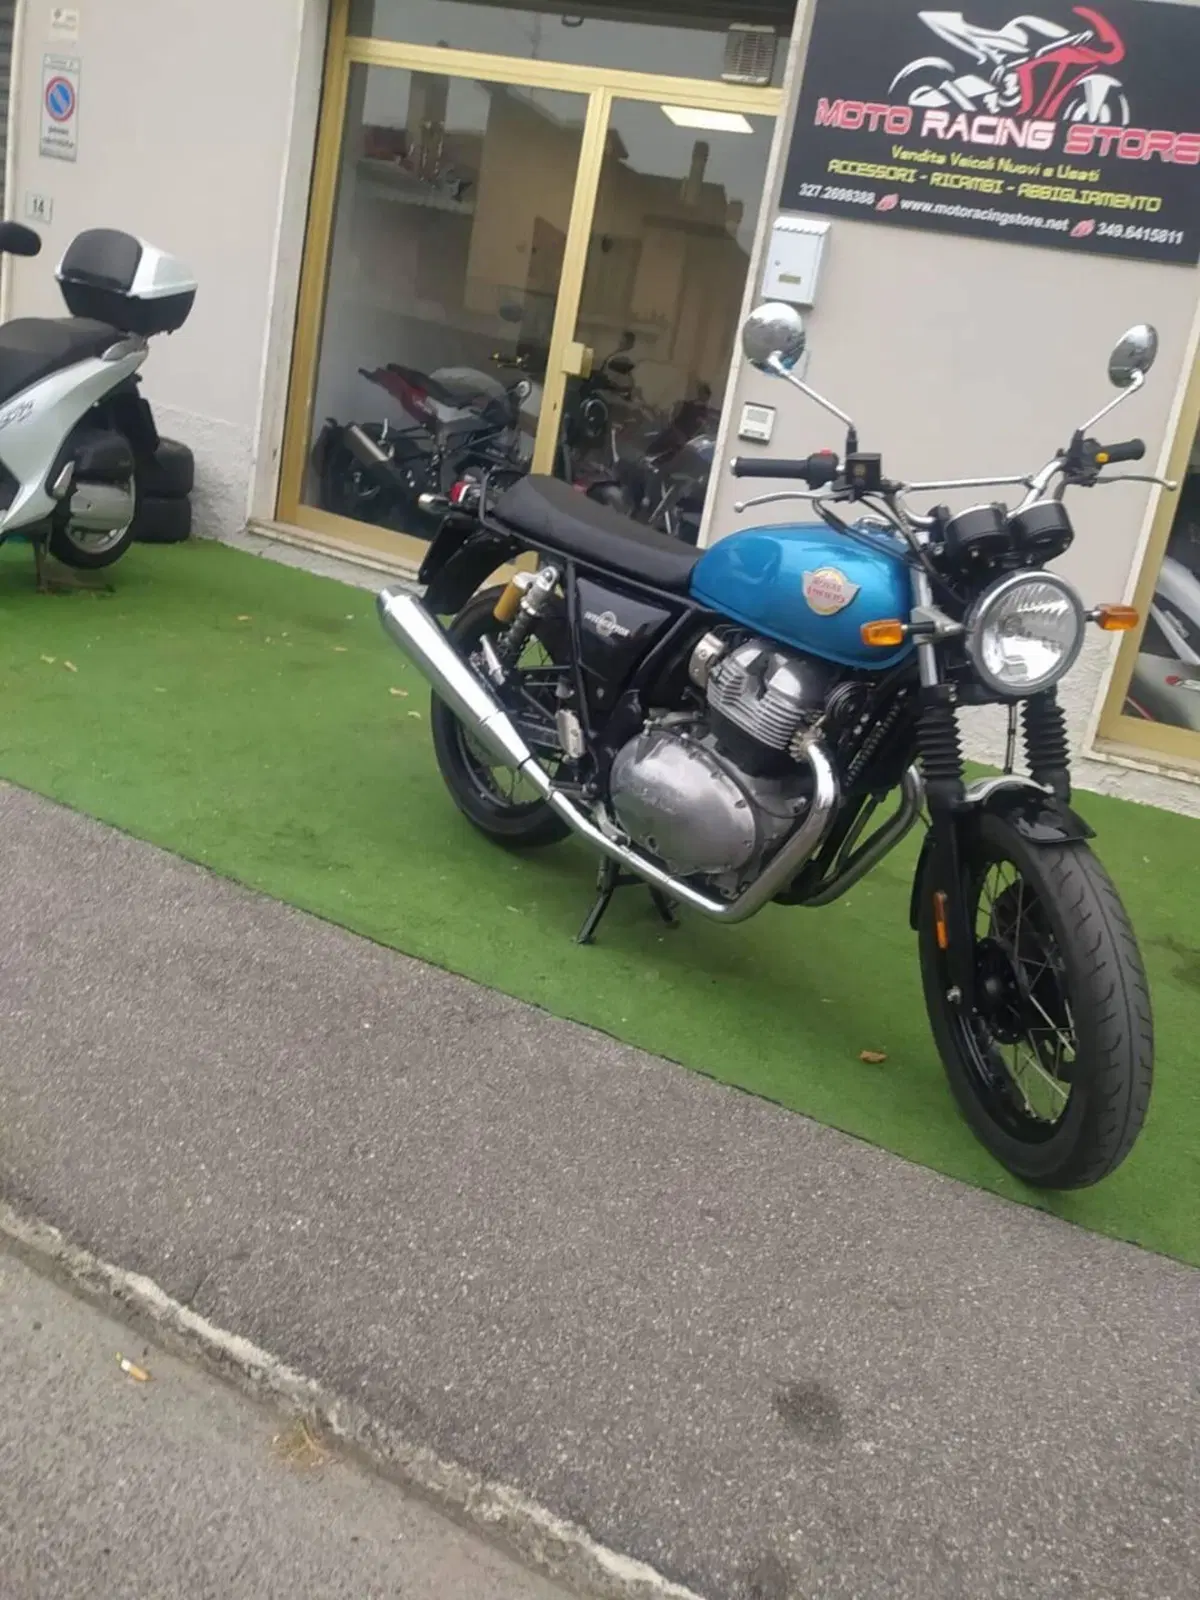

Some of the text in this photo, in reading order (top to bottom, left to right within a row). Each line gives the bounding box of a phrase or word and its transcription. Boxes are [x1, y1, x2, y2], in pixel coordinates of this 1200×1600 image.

[814, 97, 1200, 165] MOTO RACING STORE
[891, 145, 1100, 182] Vendita Veicoli Nuovi e Usati
[827, 159, 918, 183] ACCESSORI
[929, 171, 1005, 194] RICAMBI
[1017, 182, 1163, 212] ABBIGLIAMENTO
[33, 198, 45, 214] 14
[900, 199, 1070, 231] www.motoracingstore.net
